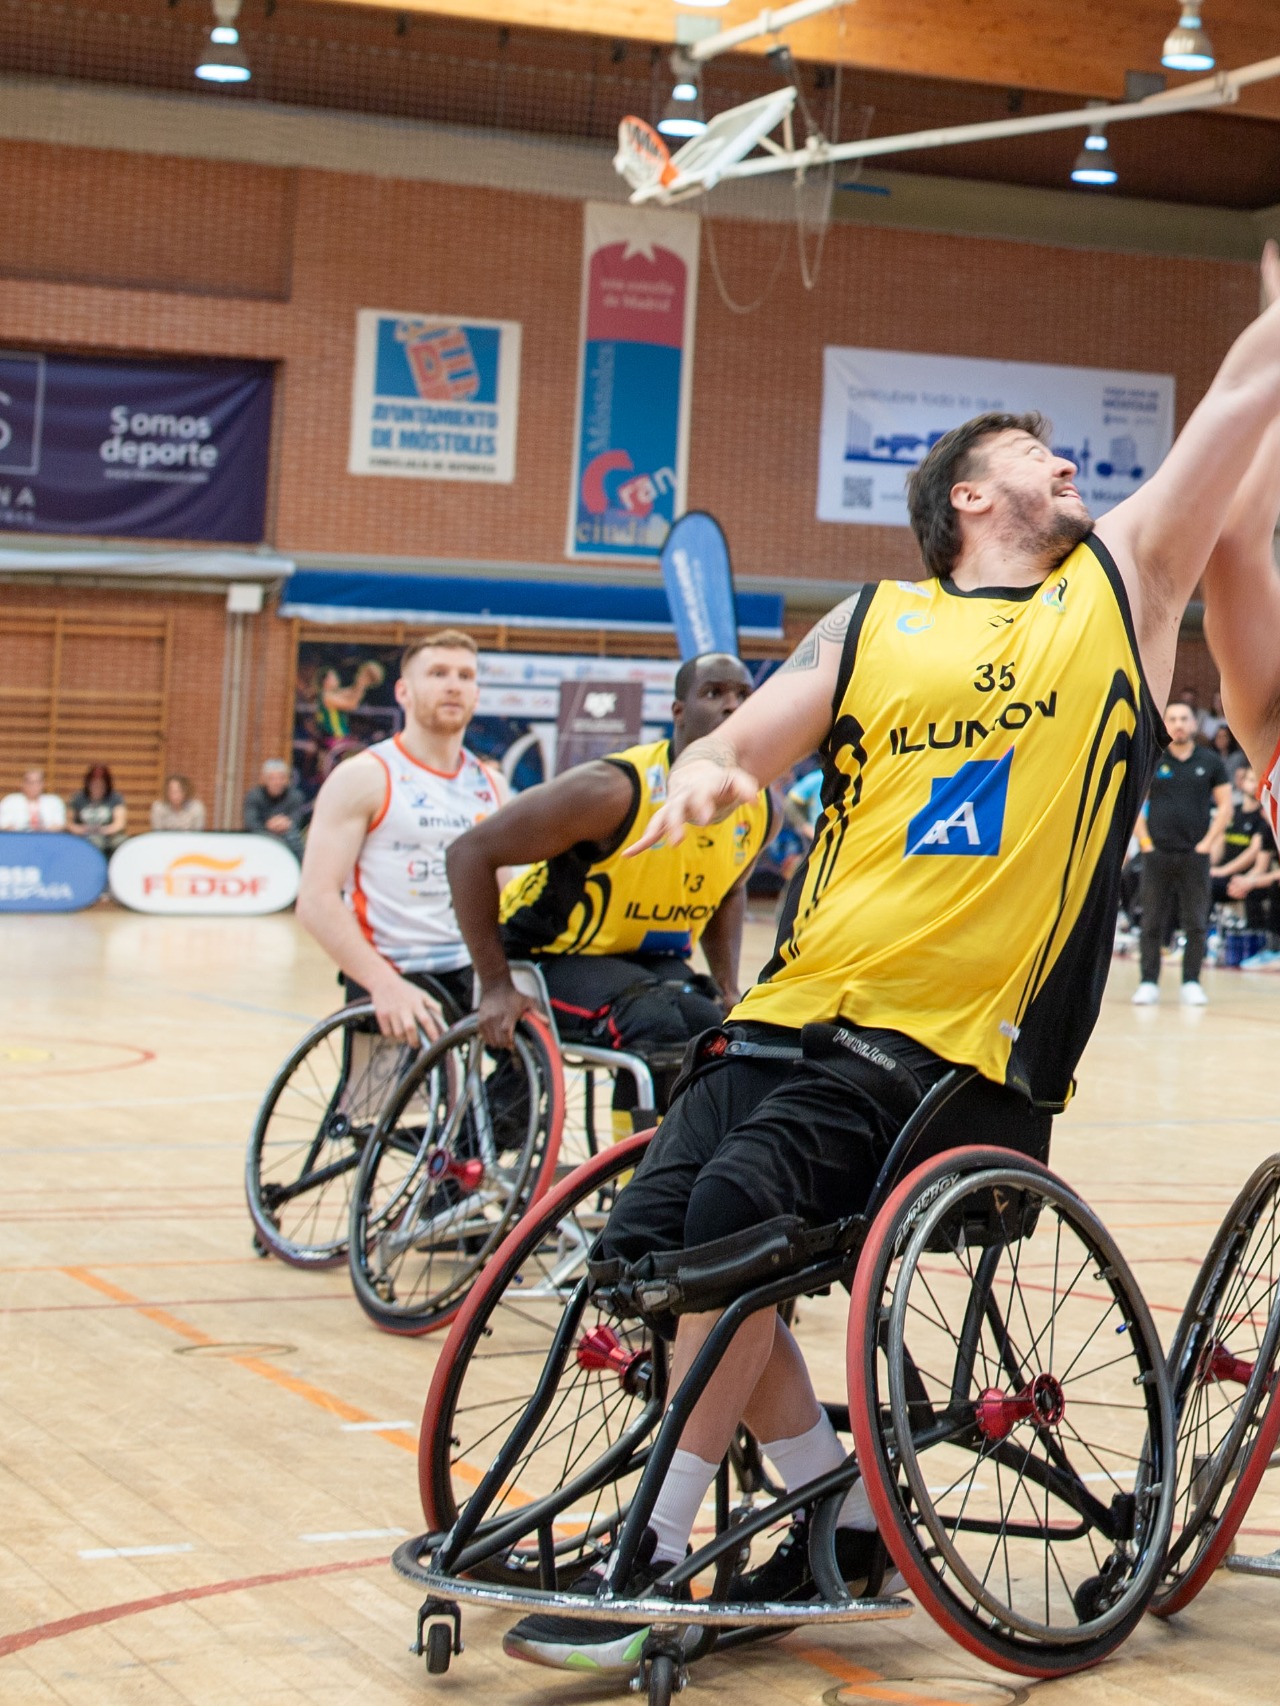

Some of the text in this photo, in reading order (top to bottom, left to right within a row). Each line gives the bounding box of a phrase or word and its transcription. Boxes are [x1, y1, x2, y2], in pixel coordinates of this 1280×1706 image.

[110, 404, 212, 440] Somos
[100, 434, 219, 469] deporte
[973, 661, 1017, 692] 35
[684, 873, 705, 893] 13
